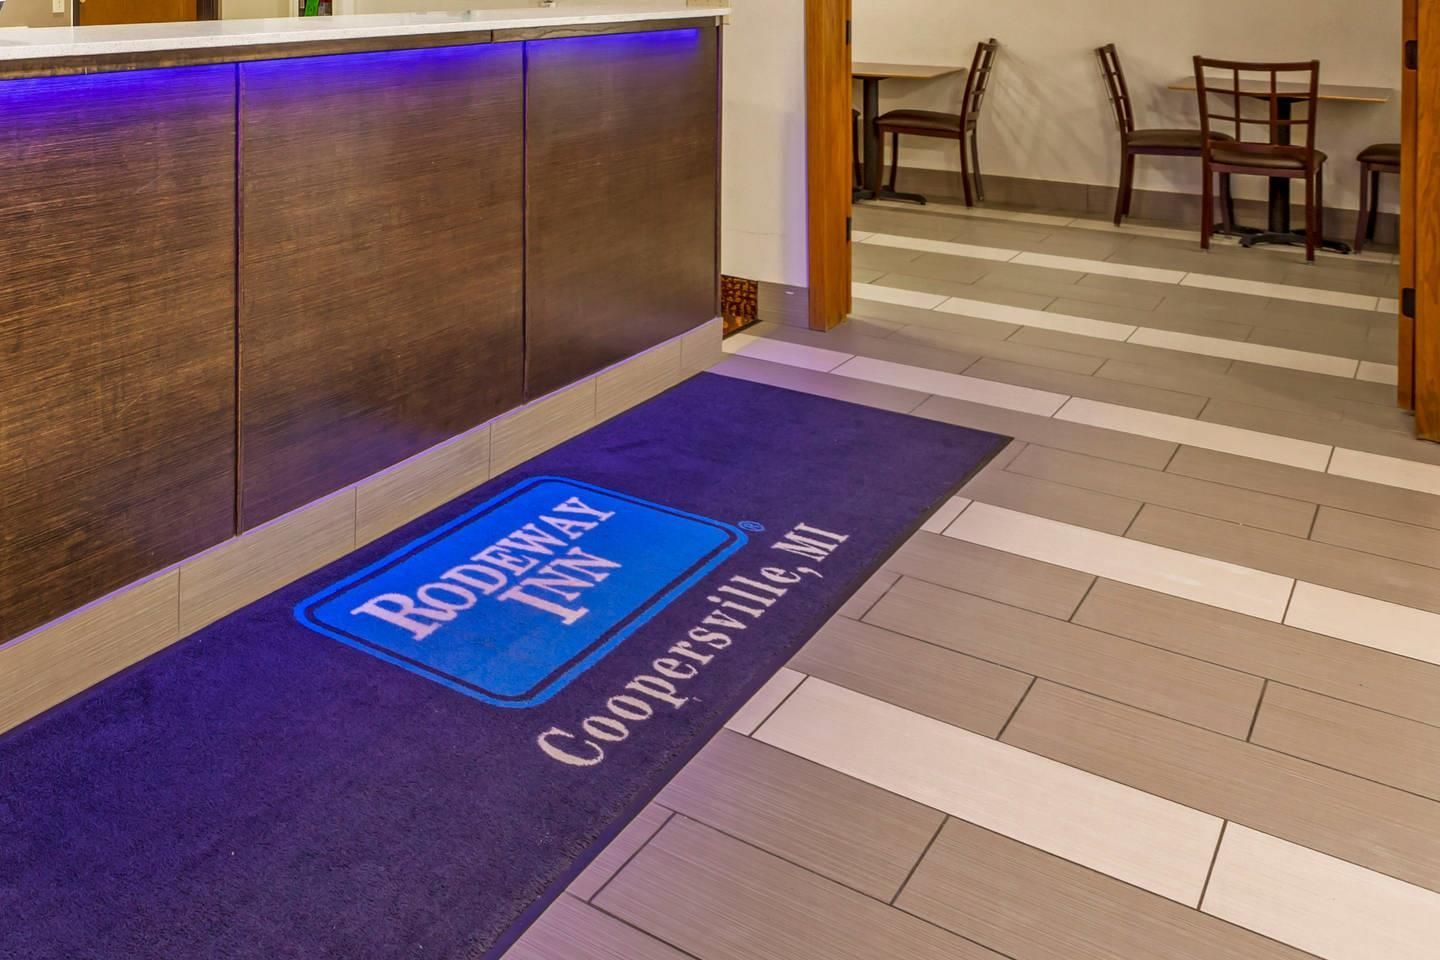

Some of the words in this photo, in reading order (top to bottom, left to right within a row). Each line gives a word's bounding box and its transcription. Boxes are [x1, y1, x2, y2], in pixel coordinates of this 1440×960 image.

[351, 496, 616, 641] RODEWAY
[770, 522, 849, 562] MI
[498, 546, 622, 625] INN
